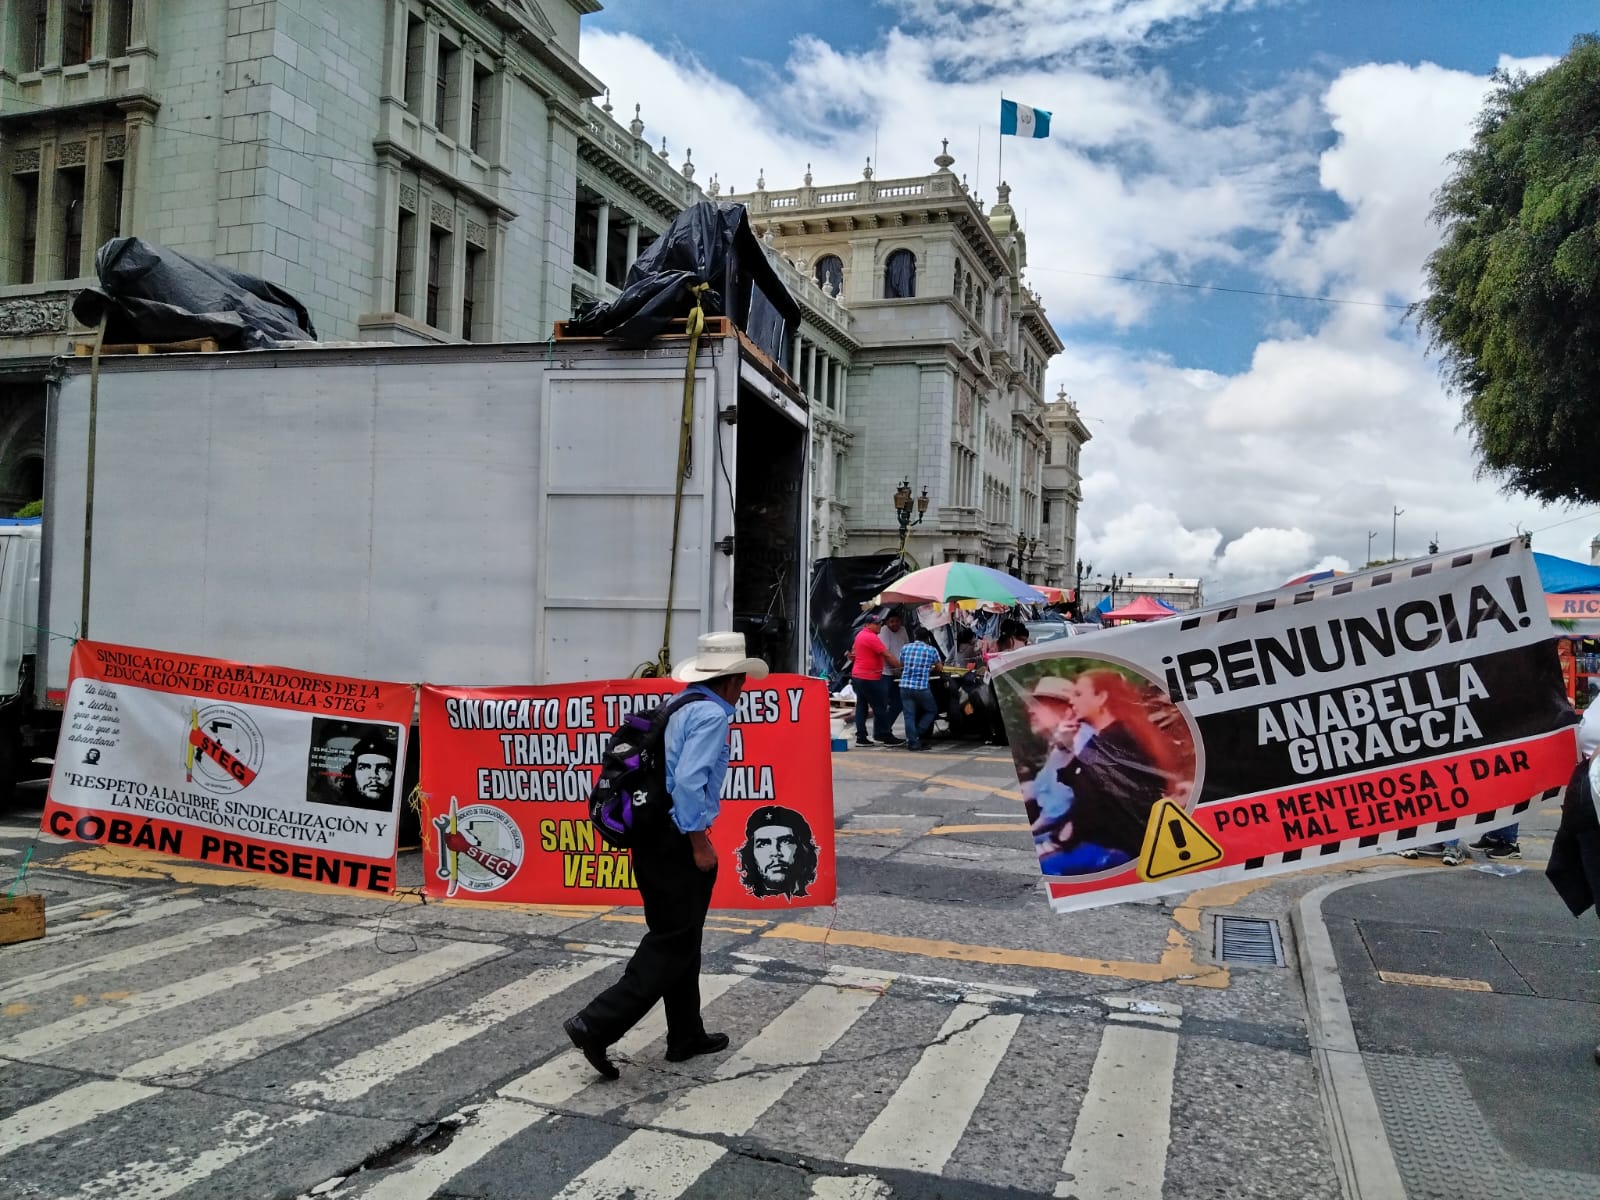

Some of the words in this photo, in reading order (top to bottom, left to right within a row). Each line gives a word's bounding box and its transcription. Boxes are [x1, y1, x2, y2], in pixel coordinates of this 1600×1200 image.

[1562, 599, 1600, 614] RIC
[97, 649, 174, 672] SINDICATO
[177, 661, 199, 676] DE
[202, 664, 331, 693] TRABAJADORES
[334, 682, 358, 697] DE
[360, 684, 379, 699] LA
[192, 678, 214, 693] DE
[446, 698, 560, 730] SINDICATO
[566, 696, 595, 729] DE
[787, 688, 804, 722] Y
[1257, 663, 1490, 746] ANABELLA
[201, 737, 245, 781] STEG
[1286, 704, 1484, 776] GIRACCA
[111, 793, 131, 808] LA
[478, 763, 592, 802] EDUCACIÓN
[1214, 801, 1271, 832] POR
[1277, 770, 1433, 818] MENTIROSA
[1442, 761, 1463, 786] Y
[1470, 750, 1532, 781] DAR
[150, 785, 160, 799] A
[162, 788, 179, 803] LA
[181, 792, 219, 812] LIBRE
[373, 823, 387, 837] Y
[1283, 815, 1338, 843] MAL
[1347, 786, 1469, 831] EJEMPLO
[50, 811, 182, 855] COBÁN
[200, 838, 395, 893] PRESENTE
[541, 818, 594, 853] SAN
[467, 846, 511, 876] STEG
[564, 853, 638, 889] VERA
